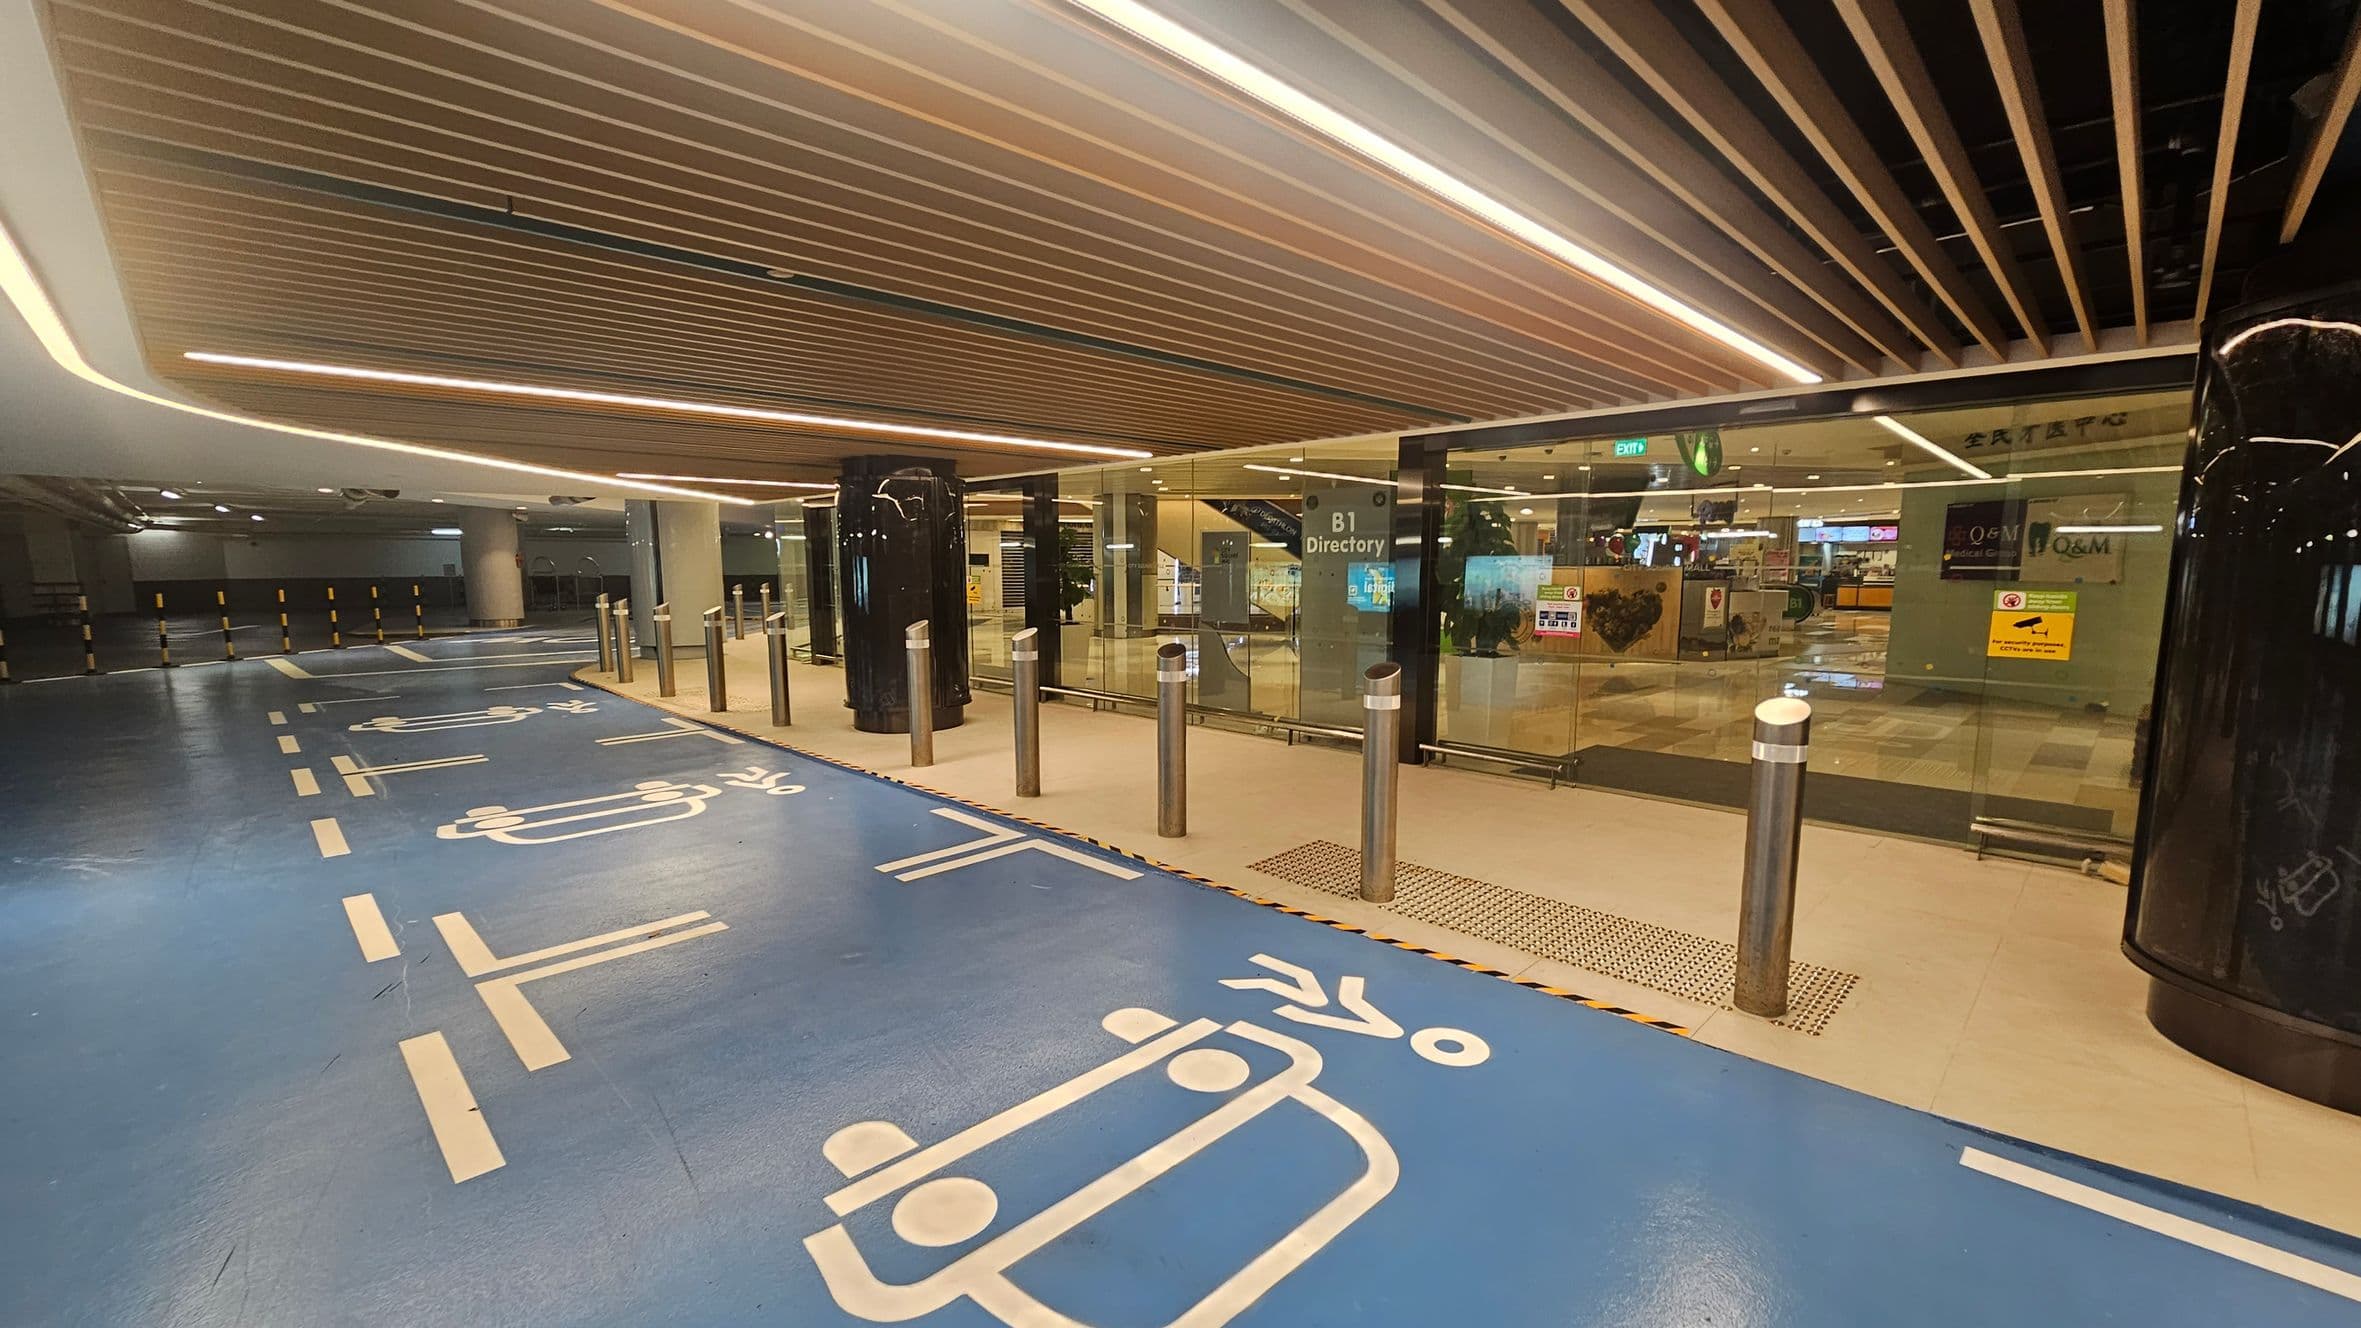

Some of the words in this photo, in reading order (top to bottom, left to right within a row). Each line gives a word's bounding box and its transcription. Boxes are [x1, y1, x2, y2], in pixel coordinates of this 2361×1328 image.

[1616, 442, 1638, 455] EXIT
[1332, 511, 1356, 533] B1
[1306, 536, 1385, 558] Directory
[2052, 535, 2112, 559] Q&M
